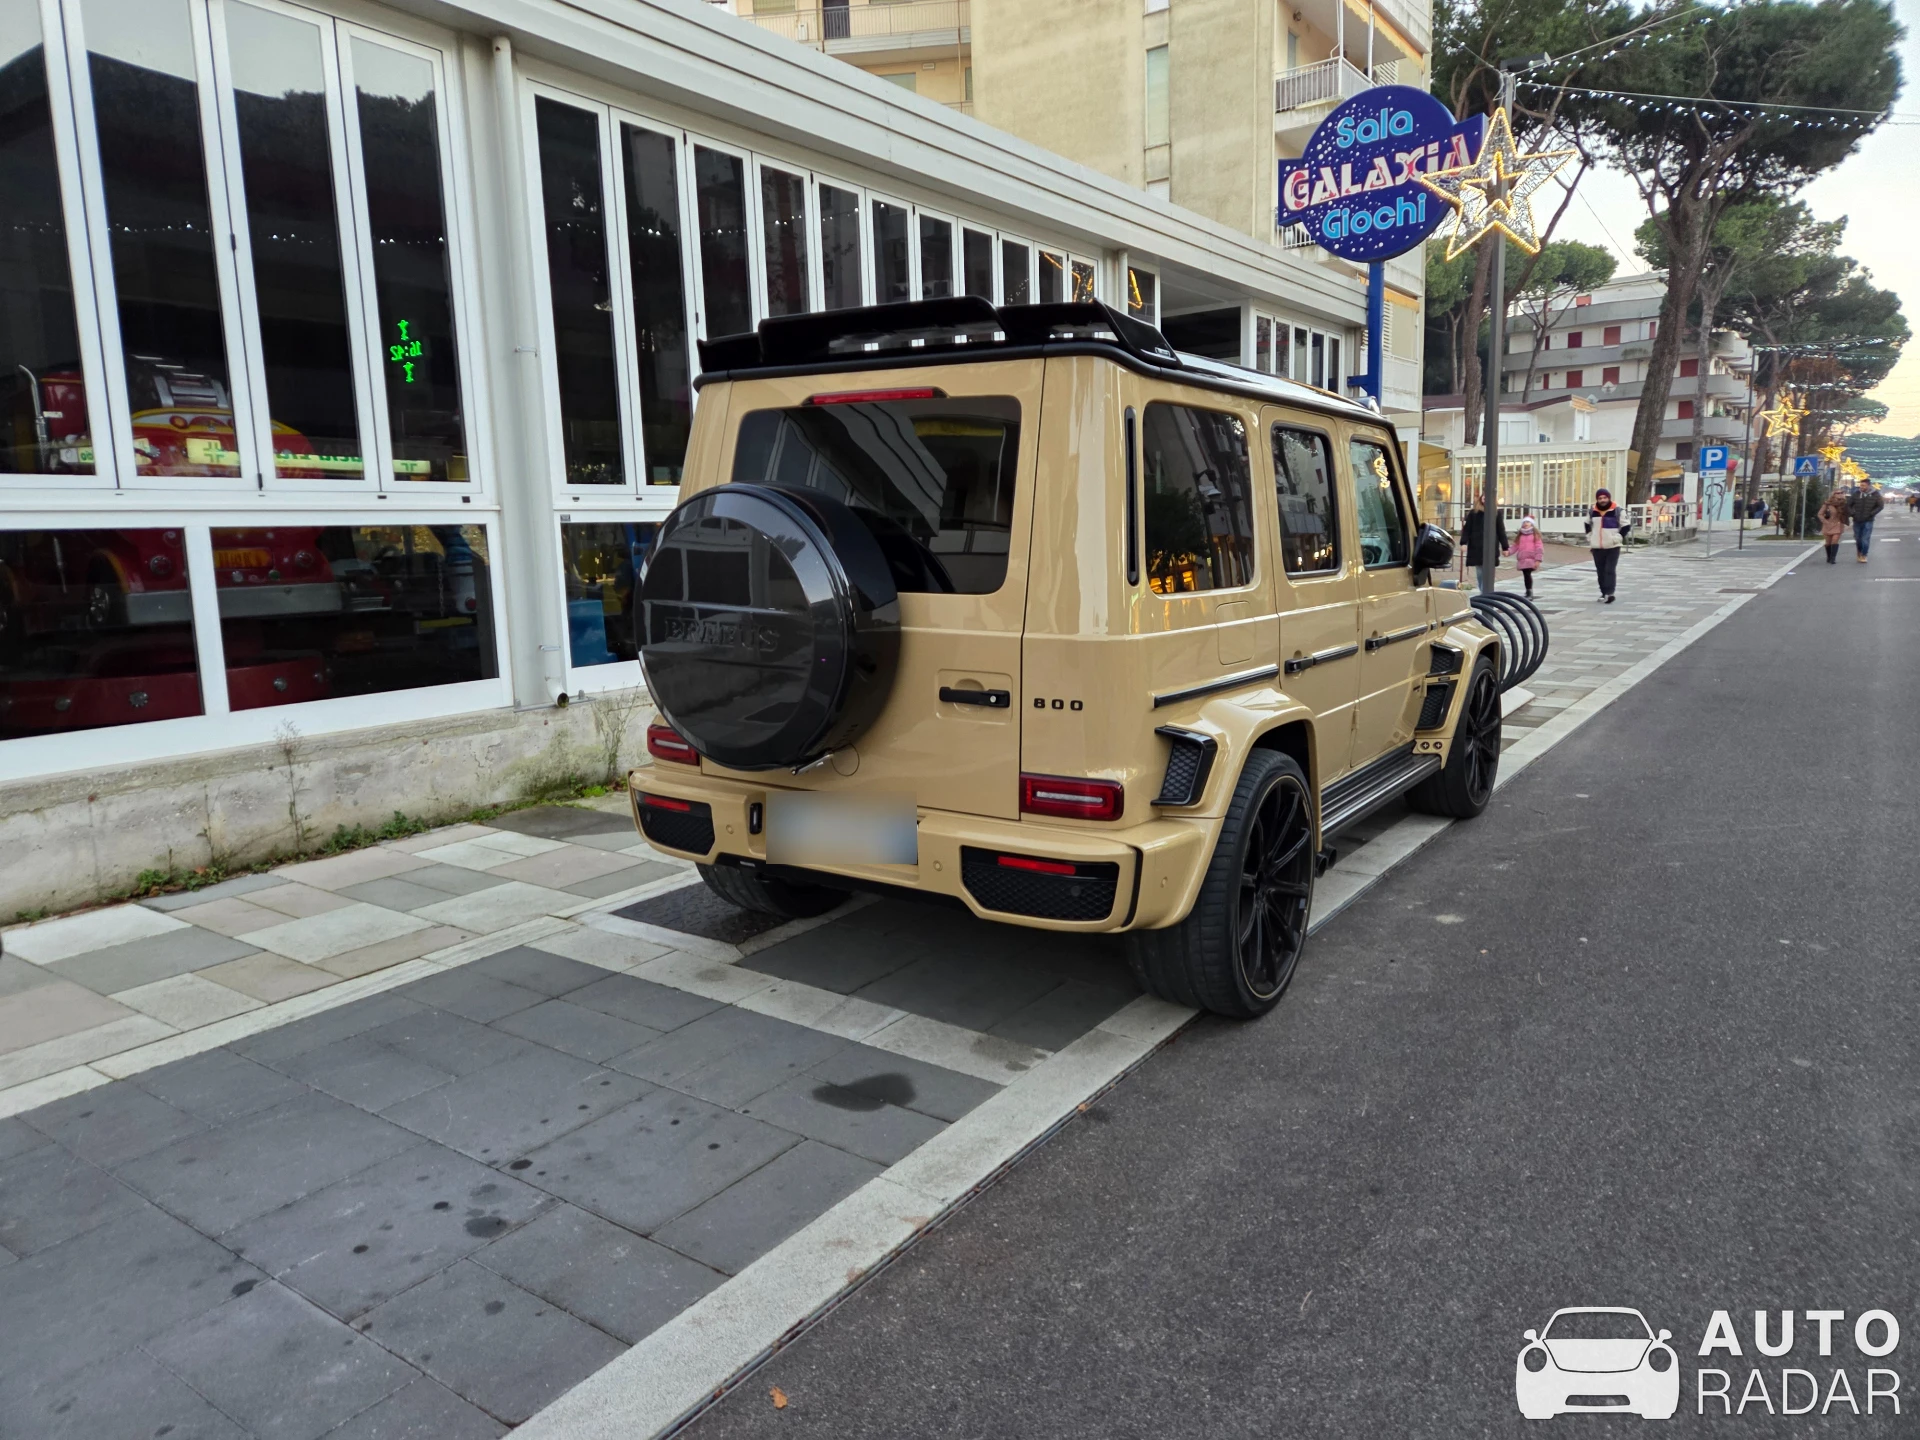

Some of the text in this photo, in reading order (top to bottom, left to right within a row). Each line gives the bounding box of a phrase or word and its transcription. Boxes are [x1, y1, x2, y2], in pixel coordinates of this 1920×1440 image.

[1336, 108, 1414, 149] Sala
[1322, 193, 1427, 239] Giochi
[1705, 449, 1723, 467] P
[1034, 698, 1083, 711] 800
